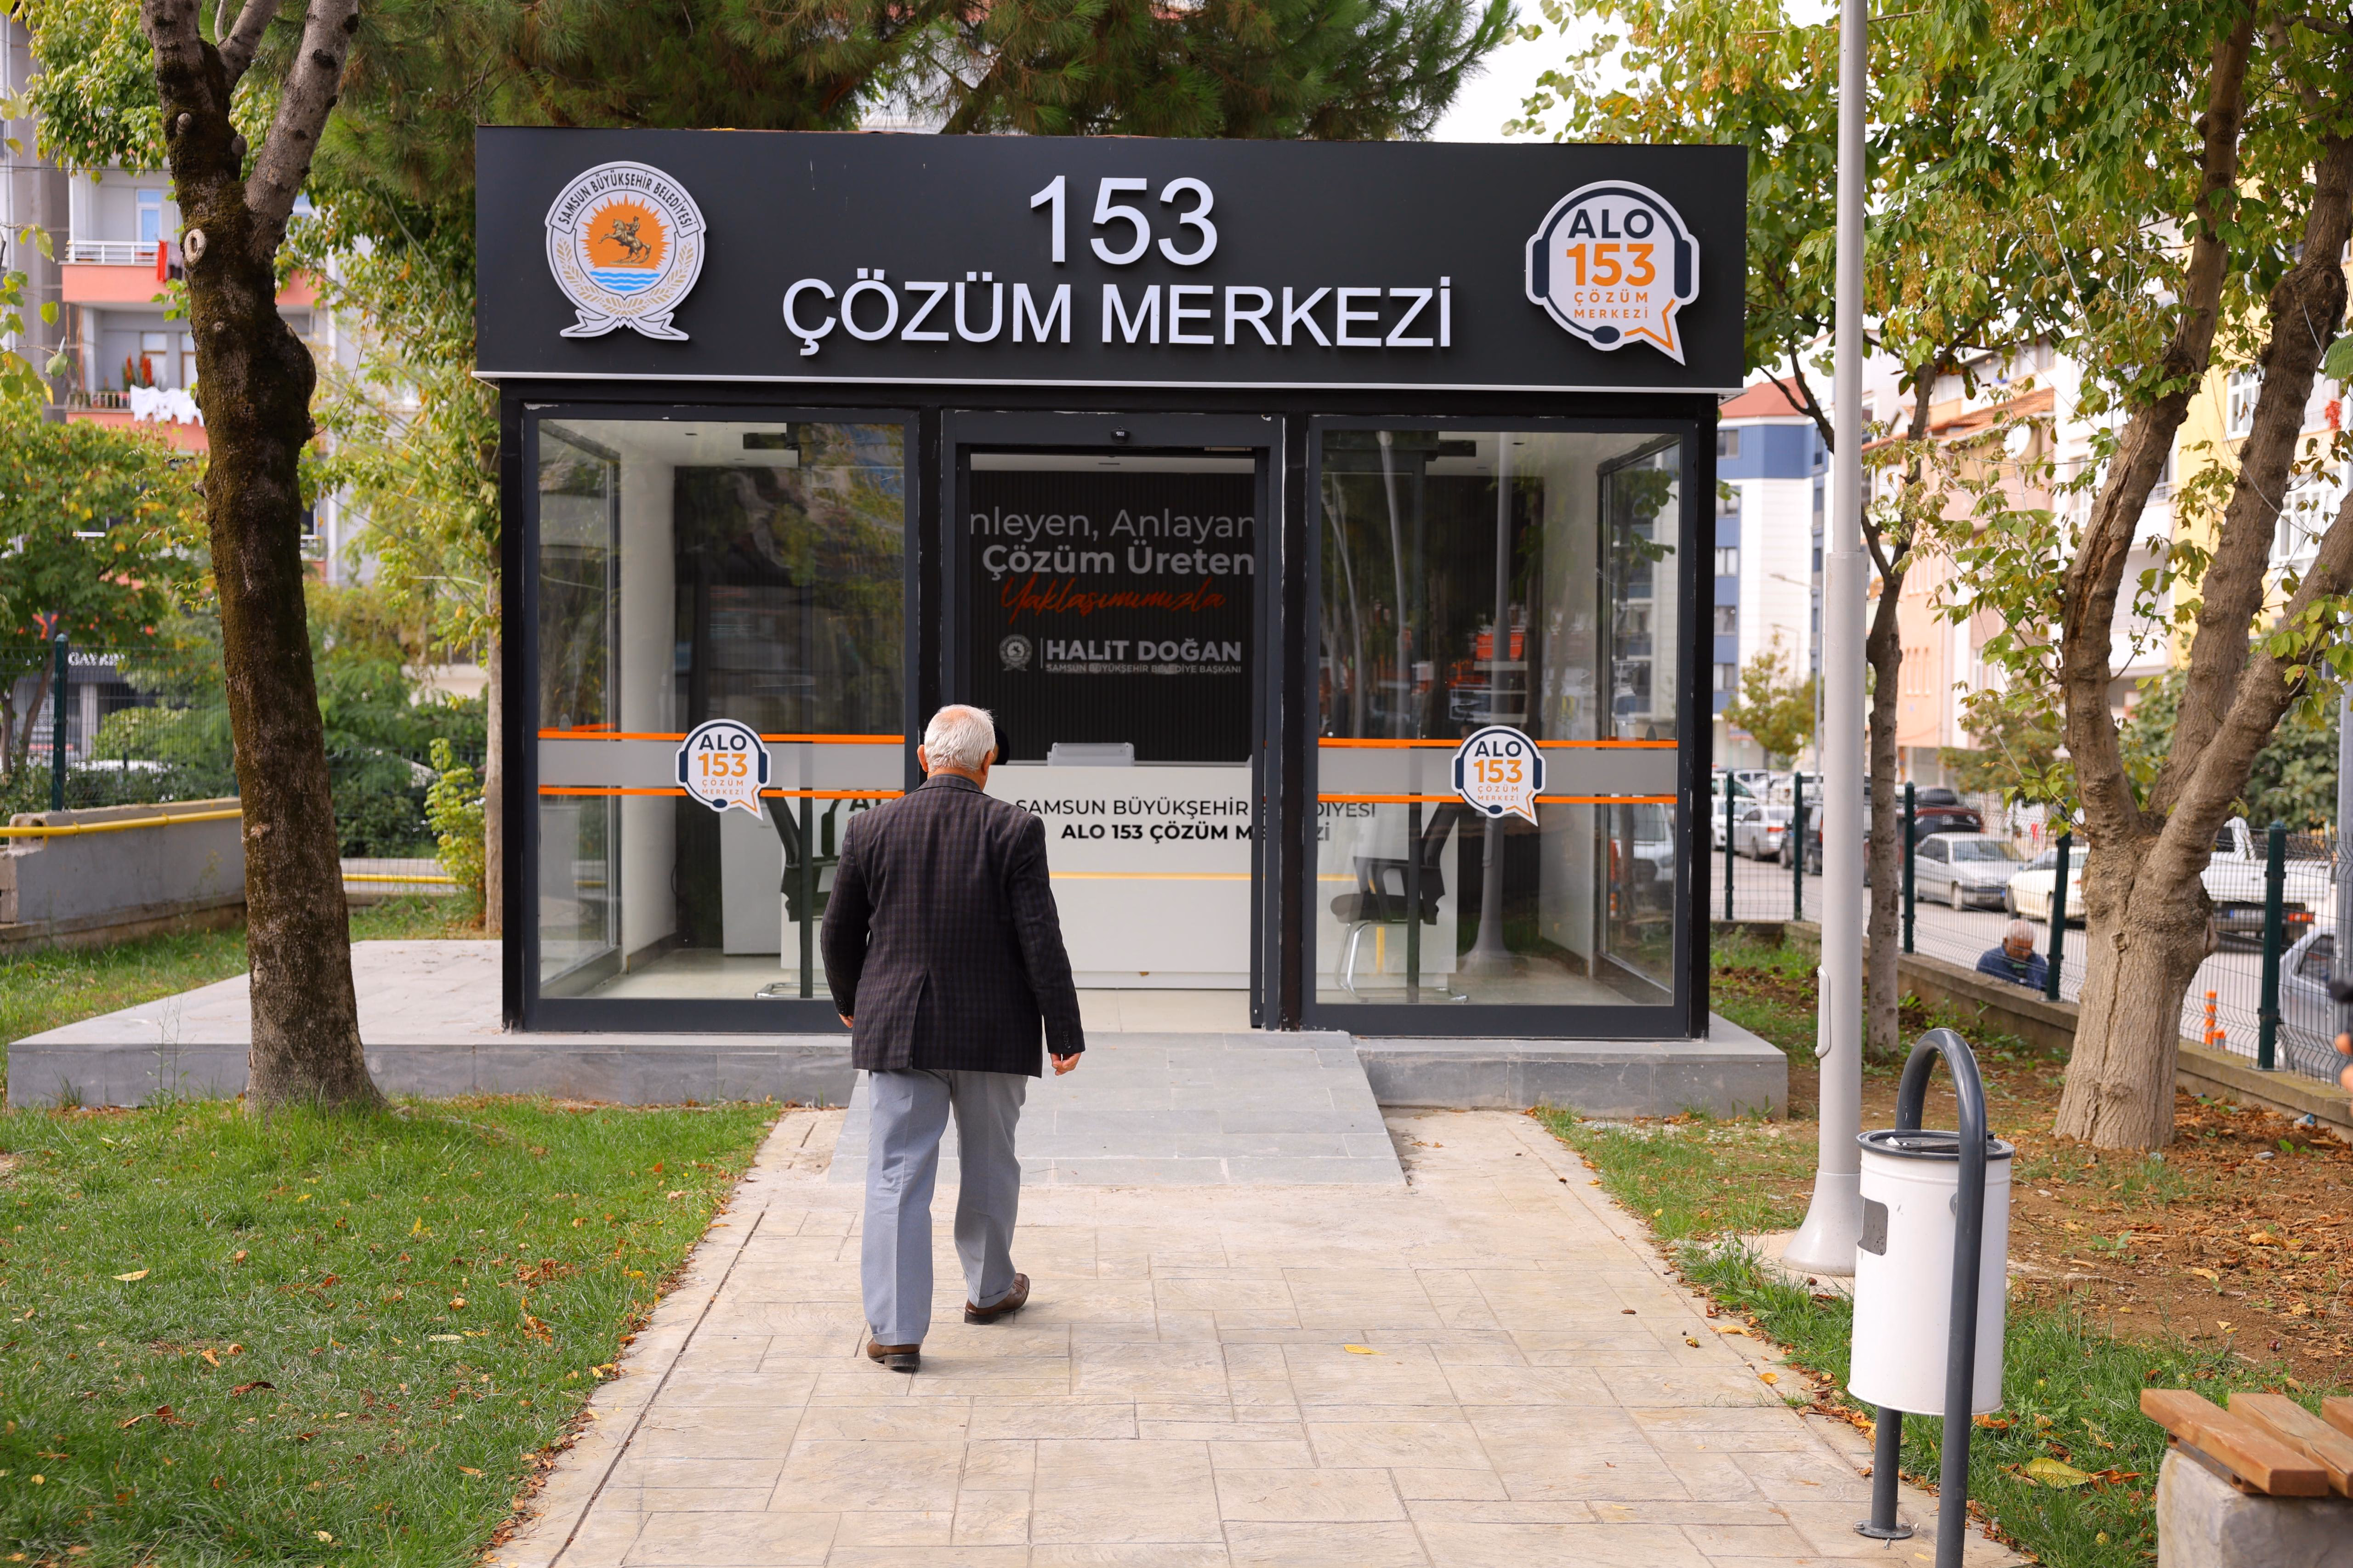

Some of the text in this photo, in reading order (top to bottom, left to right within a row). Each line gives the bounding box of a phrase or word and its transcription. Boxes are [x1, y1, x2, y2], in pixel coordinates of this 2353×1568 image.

[558, 169, 697, 228] SAMSUN BÜYÜKŞEHİR BELEDİYESİ
[1030, 175, 1218, 265] 153
[1567, 209, 1654, 239] ALO
[1566, 243, 1656, 287] 153
[1574, 289, 1648, 306] ÇÖZÜM
[782, 268, 1451, 356] ÇÖZÜM MERKEZİ
[1574, 307, 1648, 318] MERKEZİ
[1109, 508, 1254, 544] Anlayan
[983, 540, 1254, 580] Çözüm Üreten
[1047, 640, 1130, 660] HALİT
[1137, 638, 1241, 662] DOĞAN
[1046, 662, 1241, 675] SAMSUN BÜYÜKŞEHİR BELEDİYE BAŞKANI
[699, 734, 747, 751] ALO
[1474, 741, 1522, 757] ALO
[698, 753, 748, 777] 153
[1473, 759, 1523, 784] 153
[702, 778, 744, 788] ÇÖZÜM
[1478, 784, 1518, 794] ÇÖZÜM
[1016, 800, 1105, 815] SAMSUN
[1114, 796, 1248, 819] BÜYÜKŞEHİR
[1061, 824, 1105, 839] ALO
[1111, 824, 1143, 840] 153
[1150, 820, 1228, 844] ÇÖZÜM
